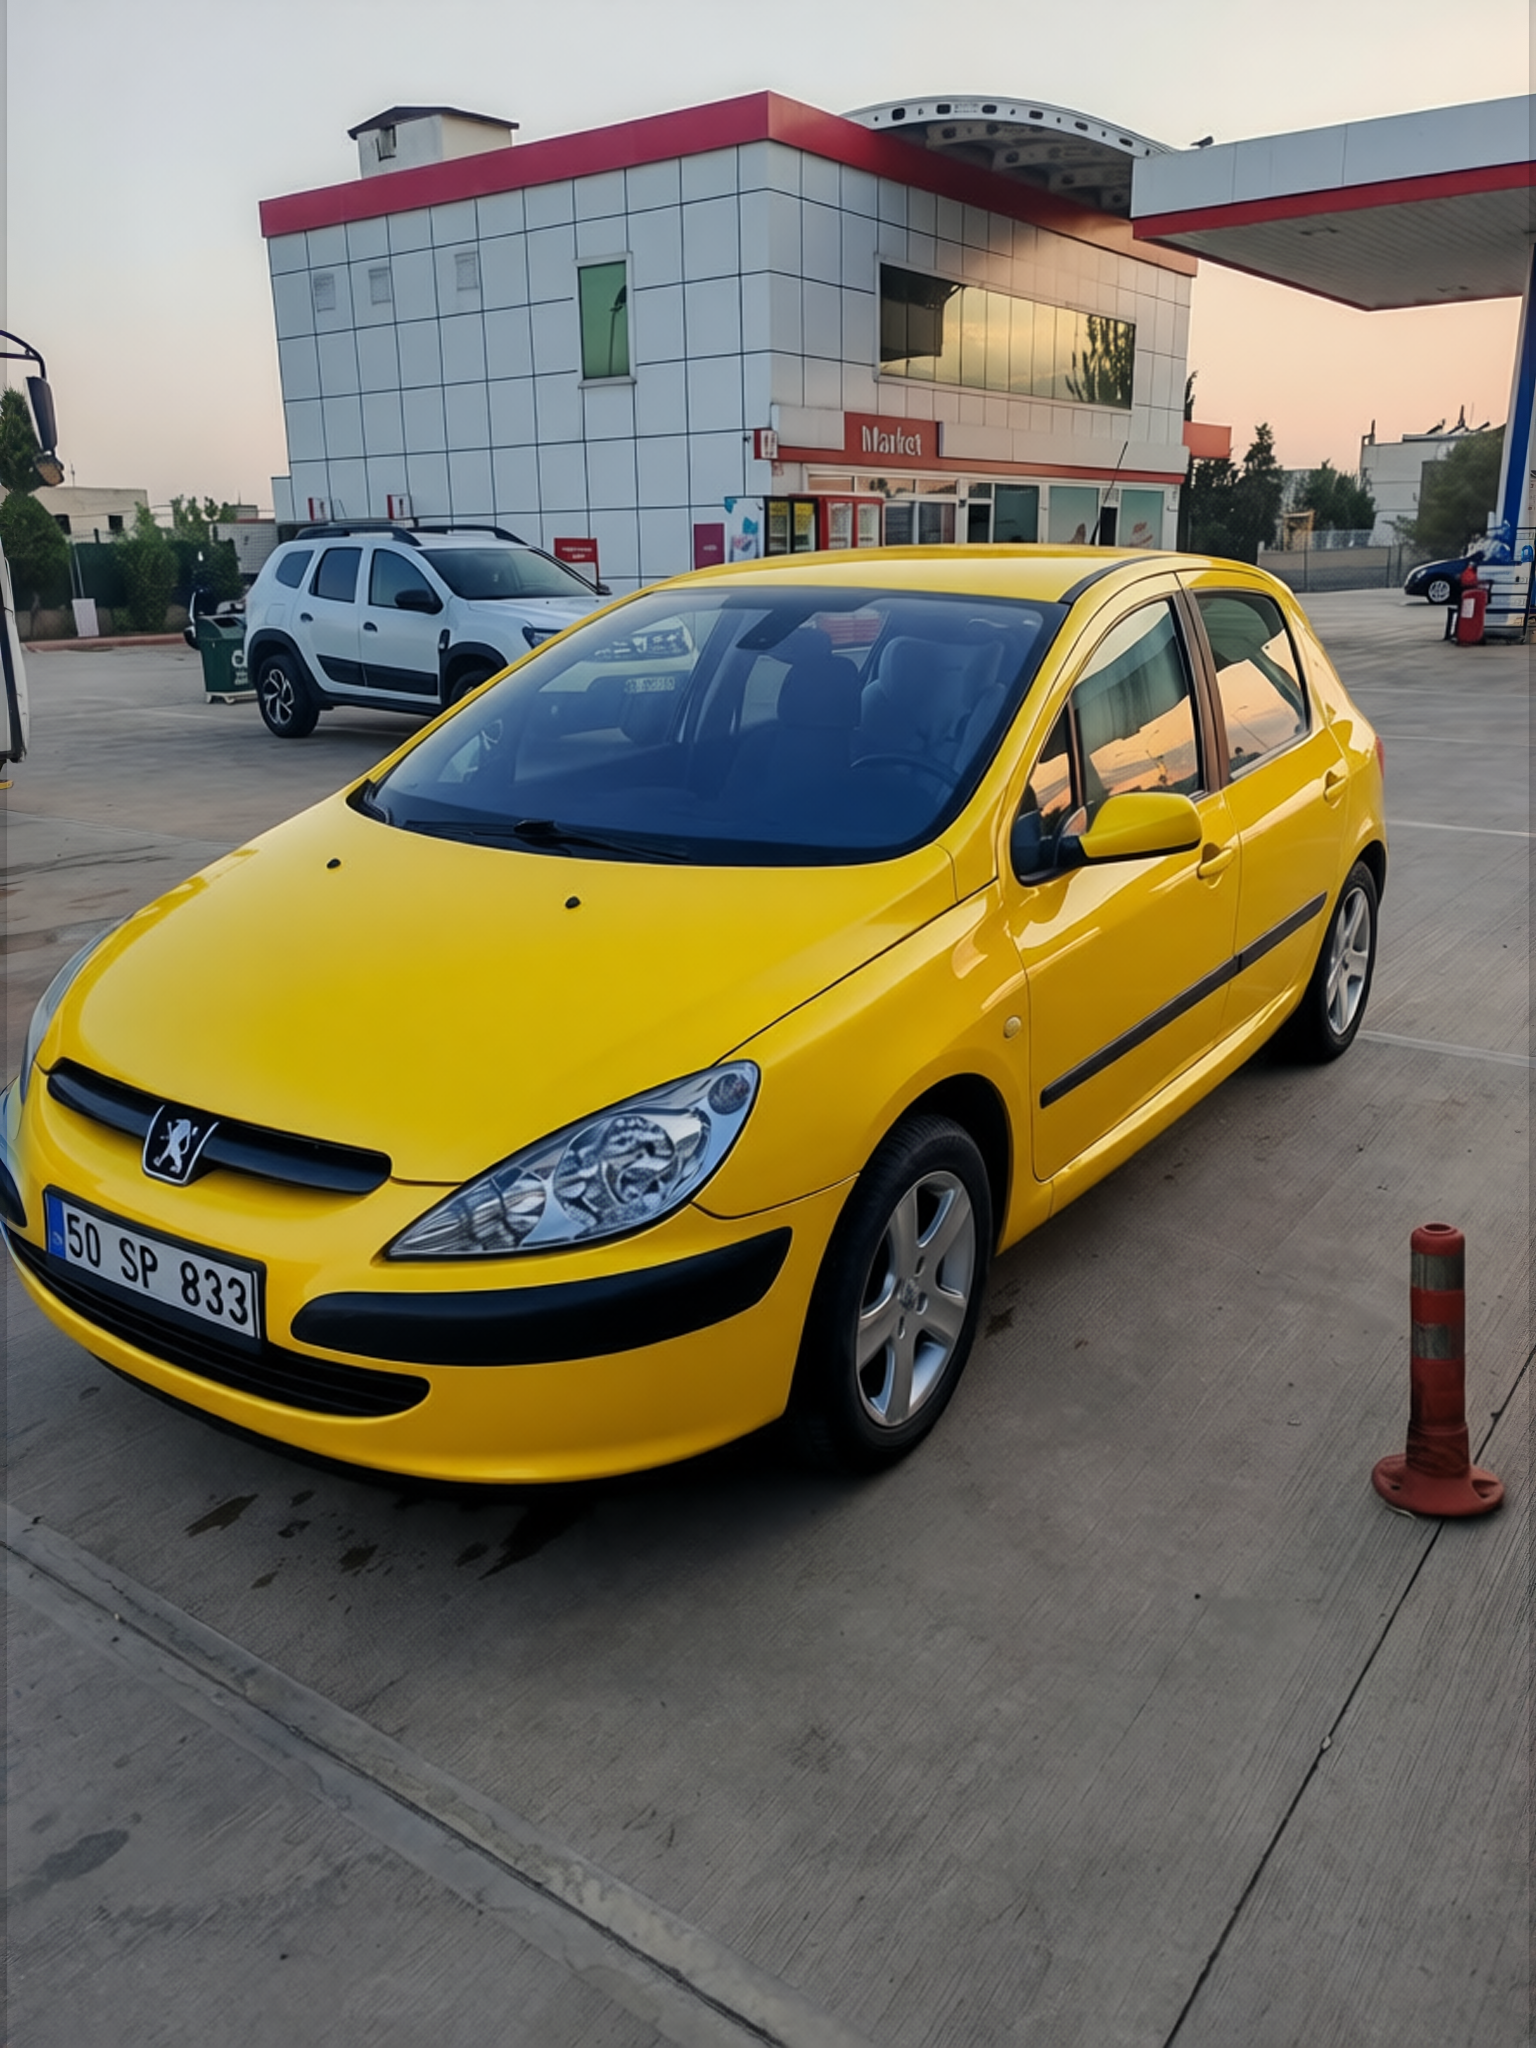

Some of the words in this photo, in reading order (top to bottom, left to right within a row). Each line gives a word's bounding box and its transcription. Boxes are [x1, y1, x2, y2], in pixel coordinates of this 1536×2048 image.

[862, 425, 922, 456] Market
[66, 1212, 101, 1269] 50
[118, 1237, 158, 1289] SP
[180, 1260, 248, 1326] 833
